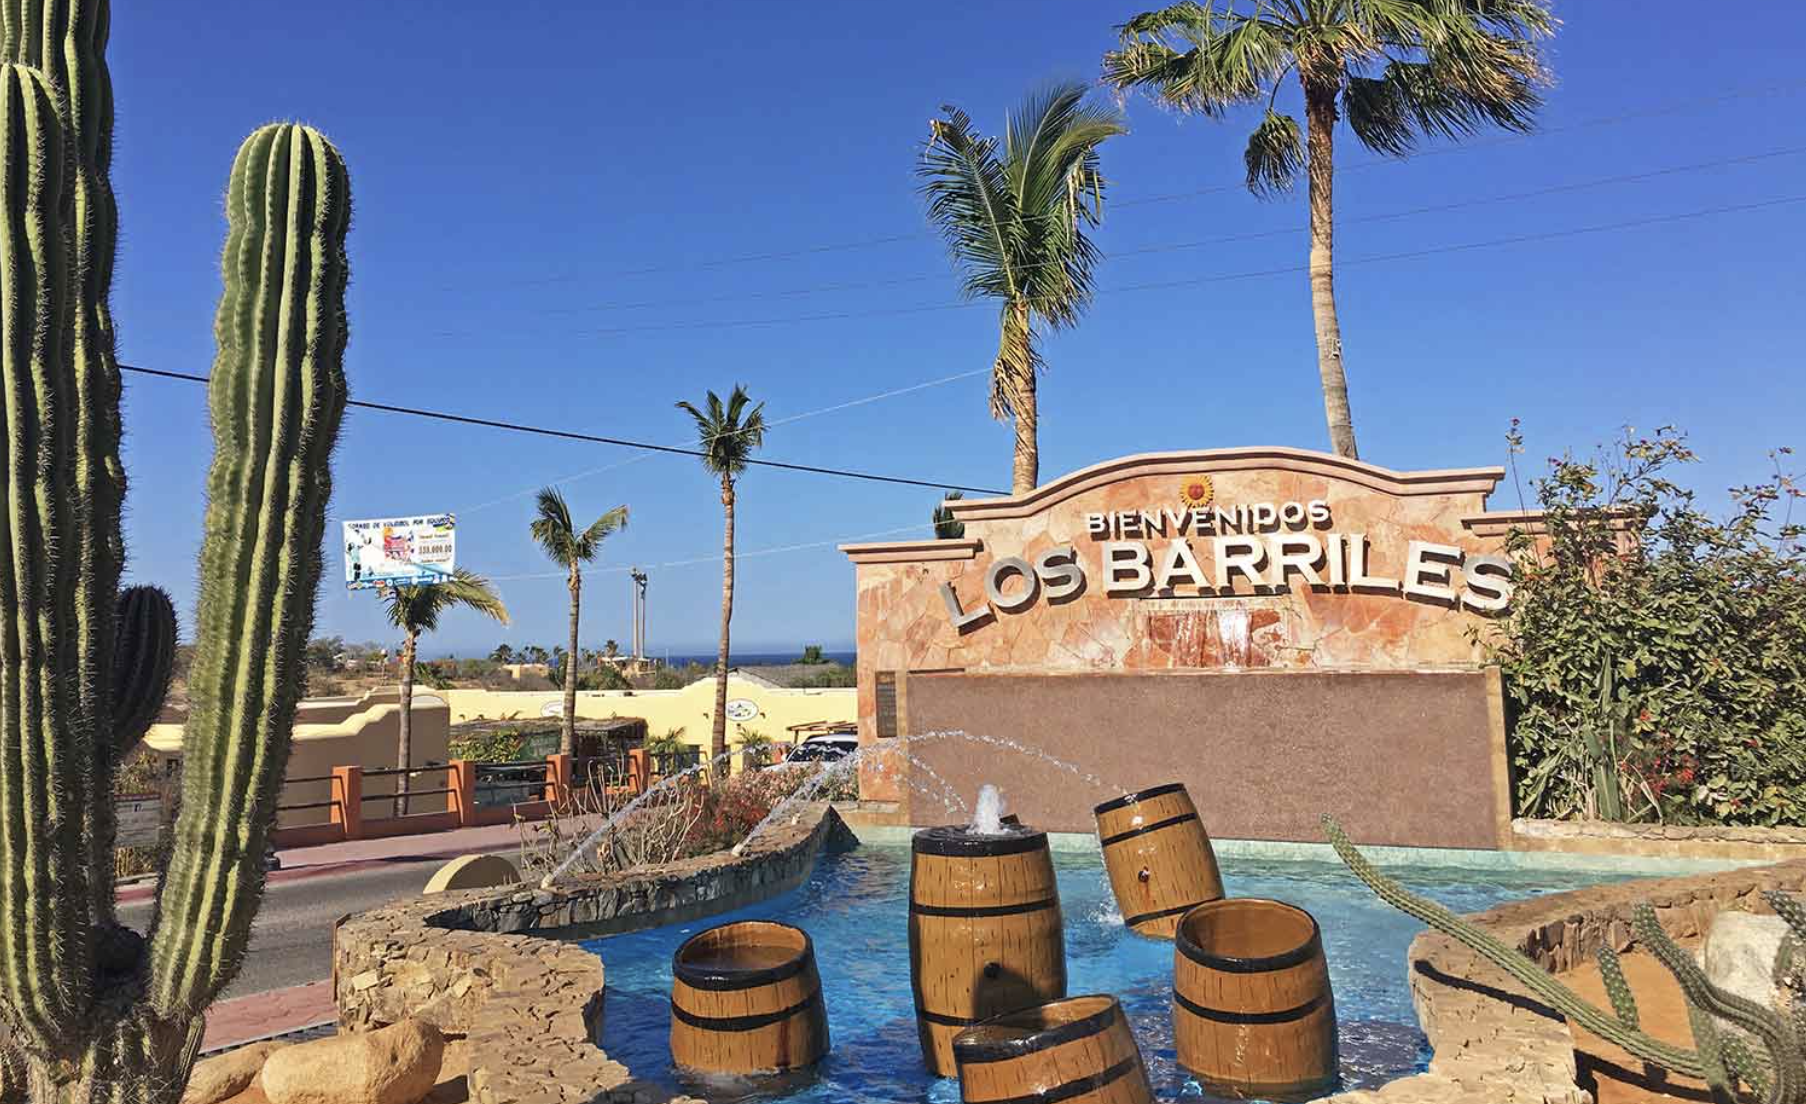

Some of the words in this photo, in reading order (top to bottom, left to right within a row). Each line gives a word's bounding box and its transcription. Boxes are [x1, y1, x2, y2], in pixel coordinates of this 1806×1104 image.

[1085, 499, 1333, 540] BIENVENIDOS
[938, 546, 1086, 634] LOS
[1102, 532, 1514, 615] BARRILES
